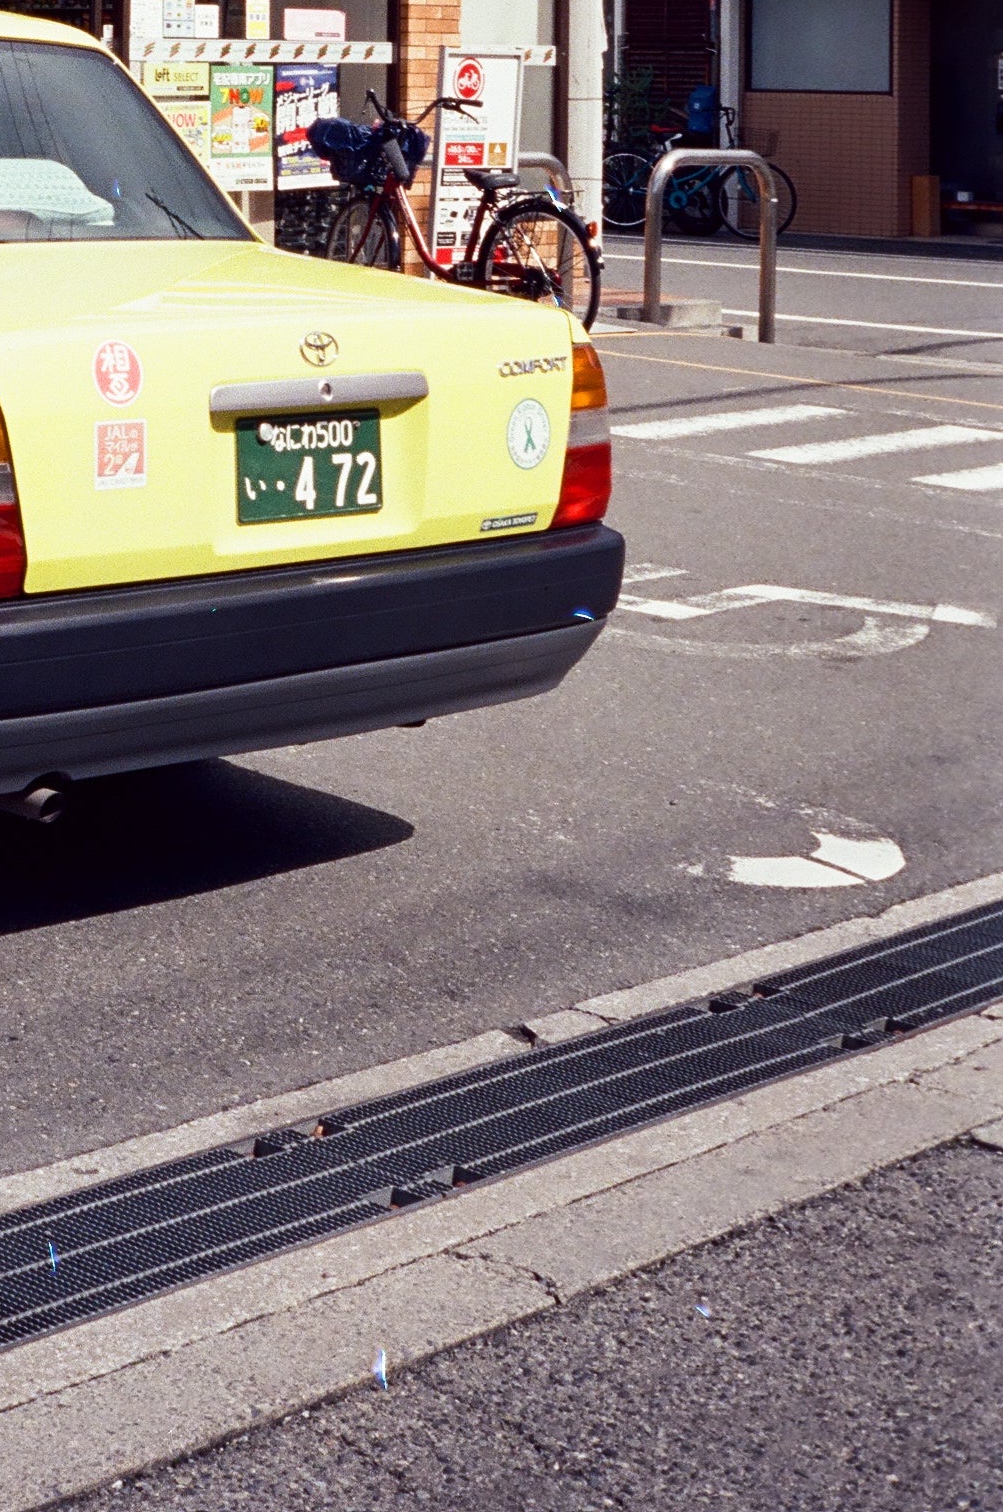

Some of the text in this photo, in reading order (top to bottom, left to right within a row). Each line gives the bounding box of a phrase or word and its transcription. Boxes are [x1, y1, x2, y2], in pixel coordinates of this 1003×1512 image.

[174, 72, 198, 81] SELECT
[219, 88, 264, 105] 7NOW
[499, 356, 567, 378] COMFORT
